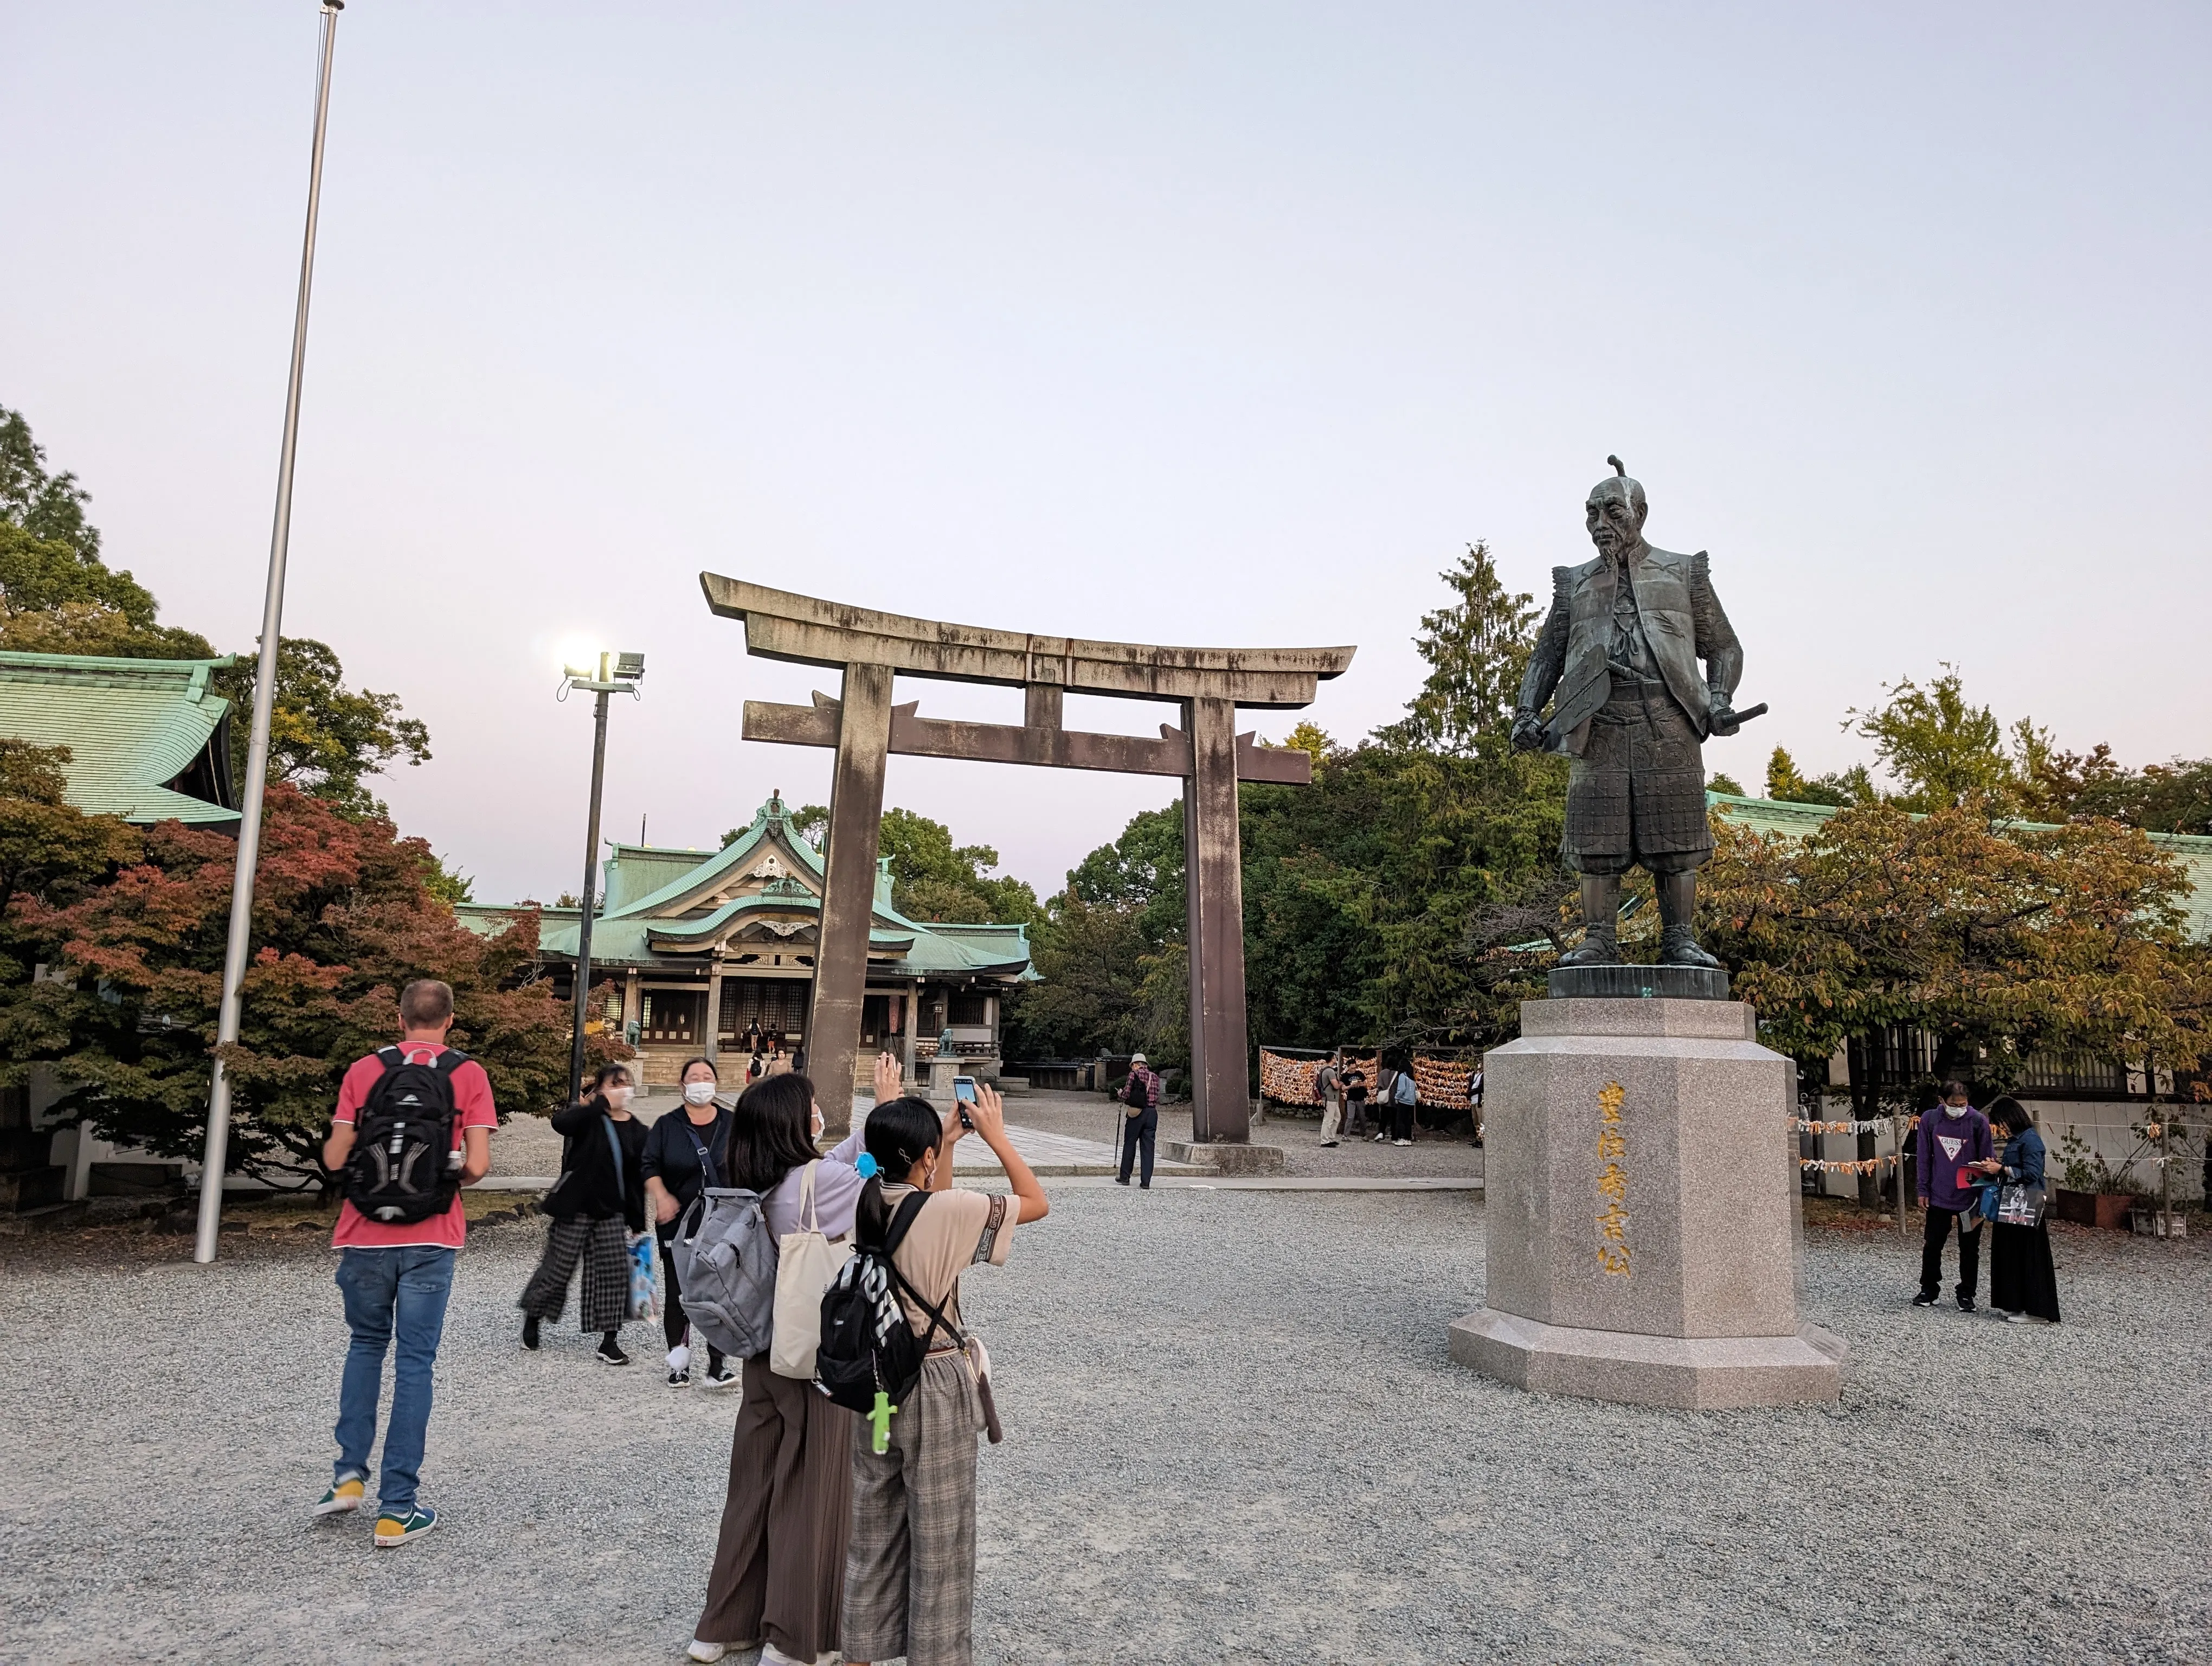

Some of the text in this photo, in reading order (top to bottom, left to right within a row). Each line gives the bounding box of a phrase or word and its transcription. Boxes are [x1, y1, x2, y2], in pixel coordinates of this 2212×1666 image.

[1596, 1080, 1632, 1277] 豊臣秀吉公
[1941, 1138, 1963, 1146] GUESS
